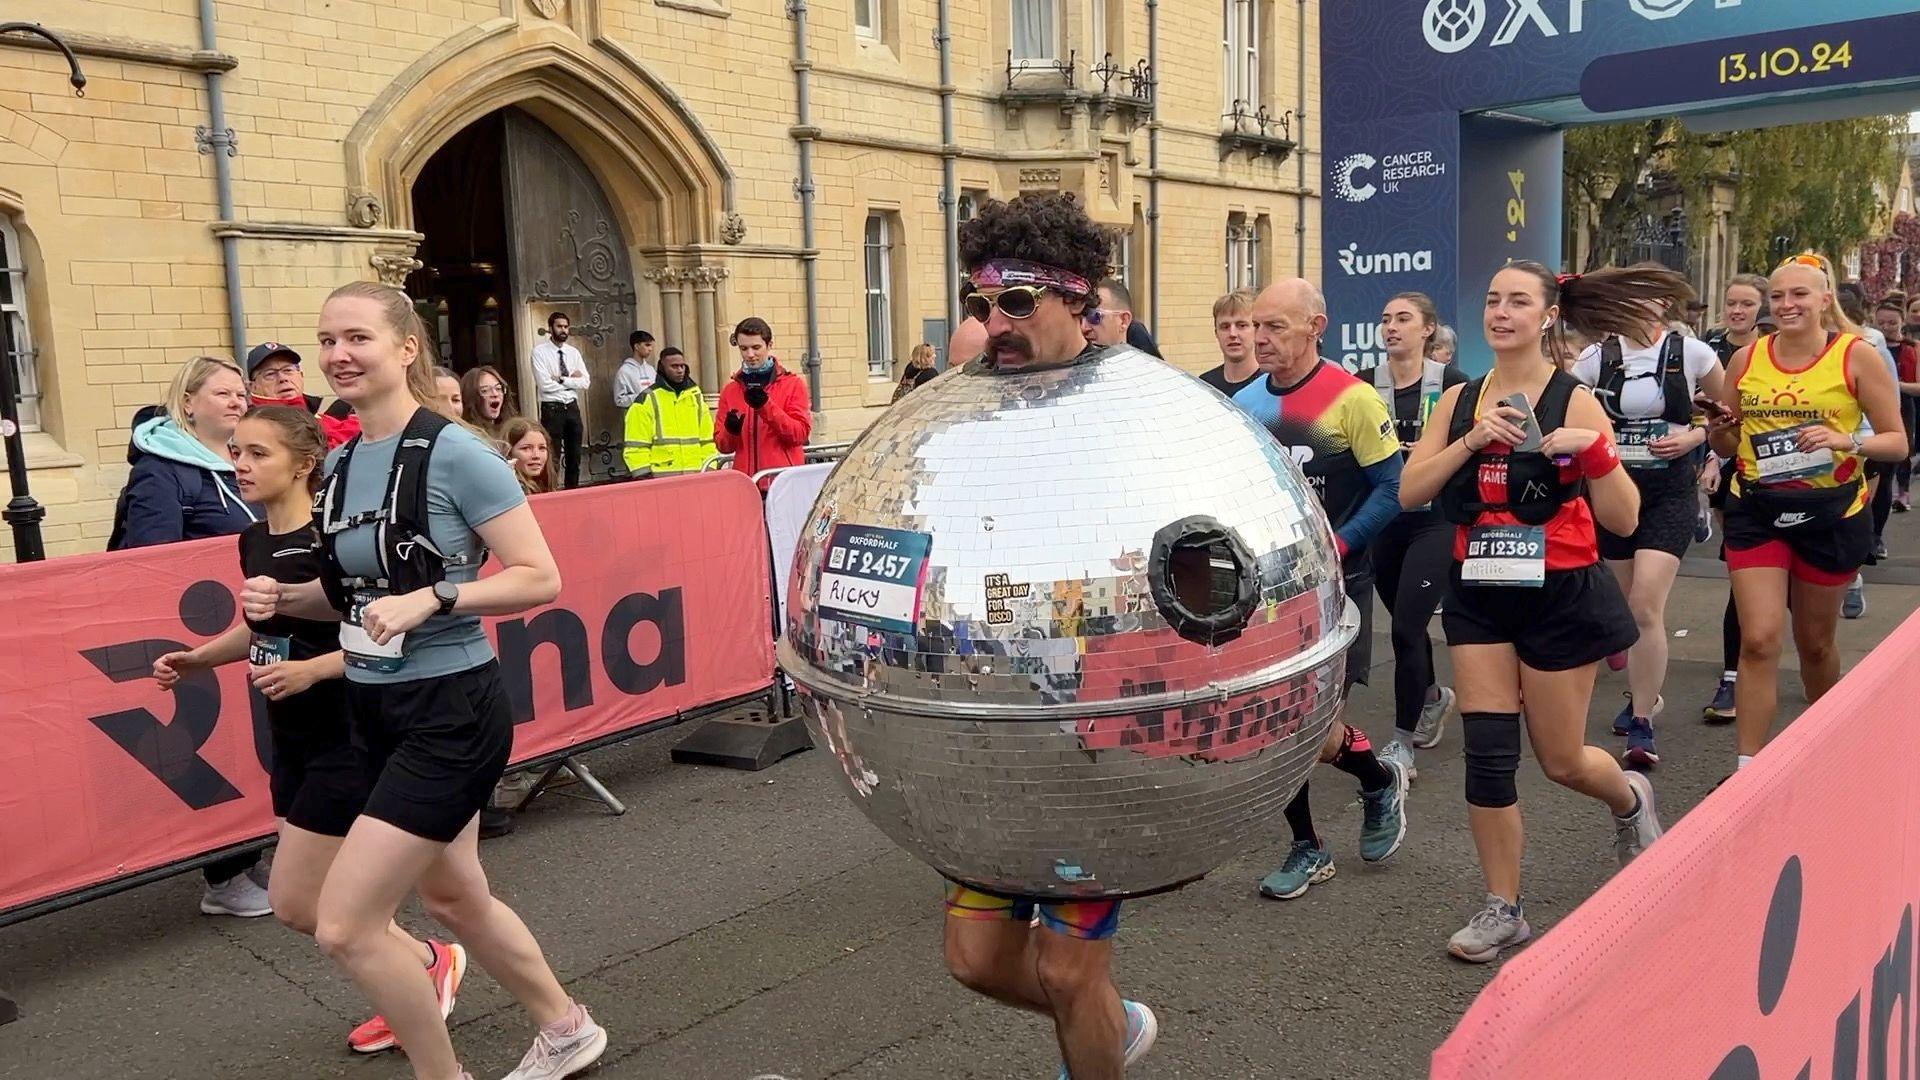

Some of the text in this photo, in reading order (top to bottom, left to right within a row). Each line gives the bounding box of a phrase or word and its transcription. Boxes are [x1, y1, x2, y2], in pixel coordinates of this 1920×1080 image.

[1719, 40, 1852, 84] 13.10.24
[1382, 151, 1432, 167] CANCER
[1382, 163, 1445, 180] RESEARCH
[1382, 181, 1400, 193] UK
[1338, 242, 1432, 275] Runna
[1821, 408, 1841, 419] UK
[1772, 442, 1781, 454] F
[1779, 512, 1806, 522] NIKE
[1480, 540, 1539, 556] F 12389
[846, 549, 912, 579] F 2457
[1002, 574, 1009, 586] A
[829, 579, 880, 608] RICKY
[986, 584, 1029, 599] GREAT DAY
[988, 599, 1004, 611] FOR
[989, 611, 1012, 623] DISCO
[79, 579, 686, 811] Rna
